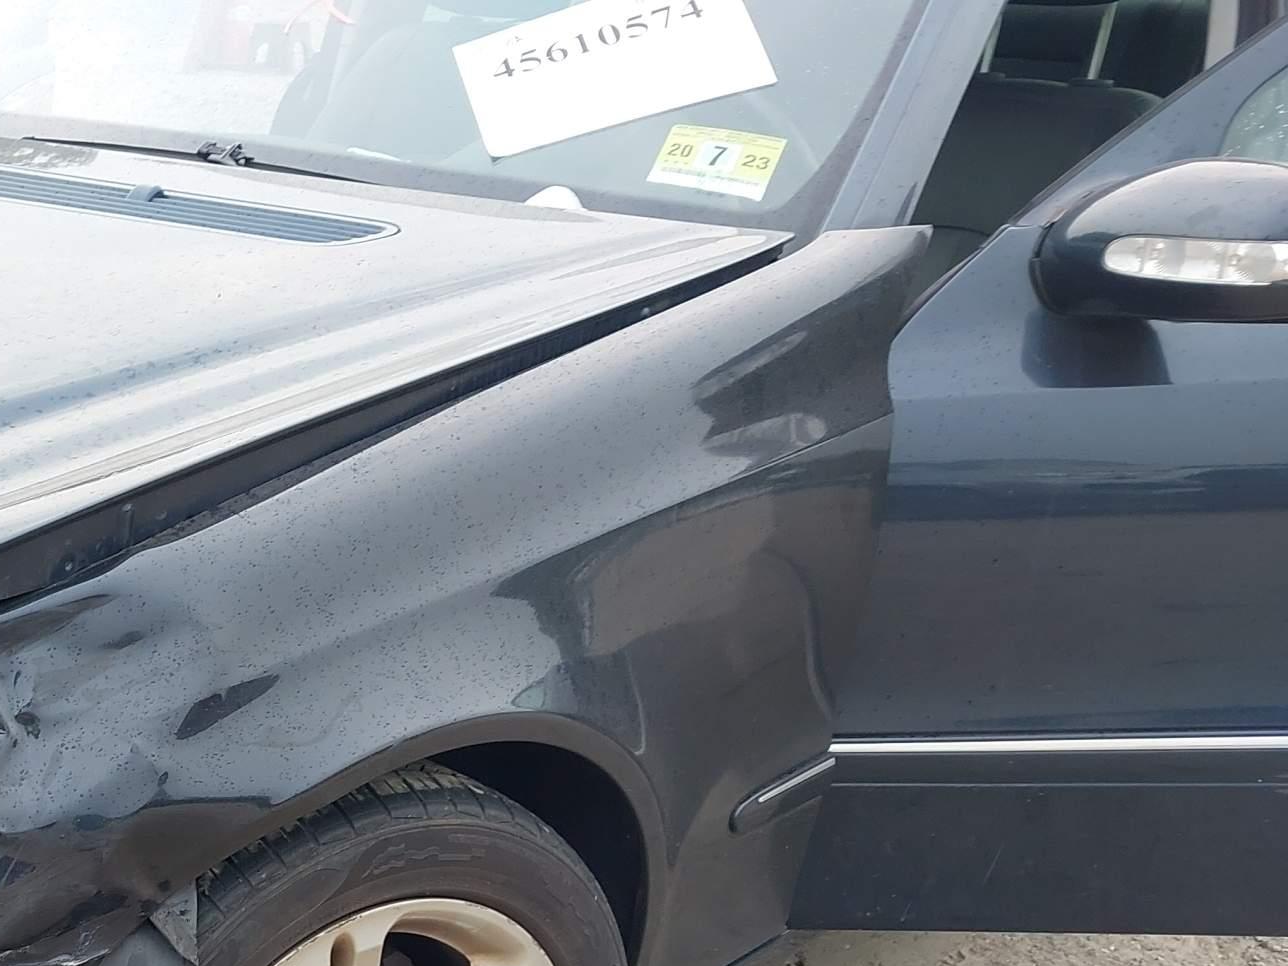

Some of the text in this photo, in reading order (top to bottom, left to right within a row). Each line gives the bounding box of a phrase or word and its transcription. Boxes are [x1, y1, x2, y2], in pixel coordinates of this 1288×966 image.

[493, 0, 704, 78] 45610574
[667, 142, 772, 171] 20 7 23
